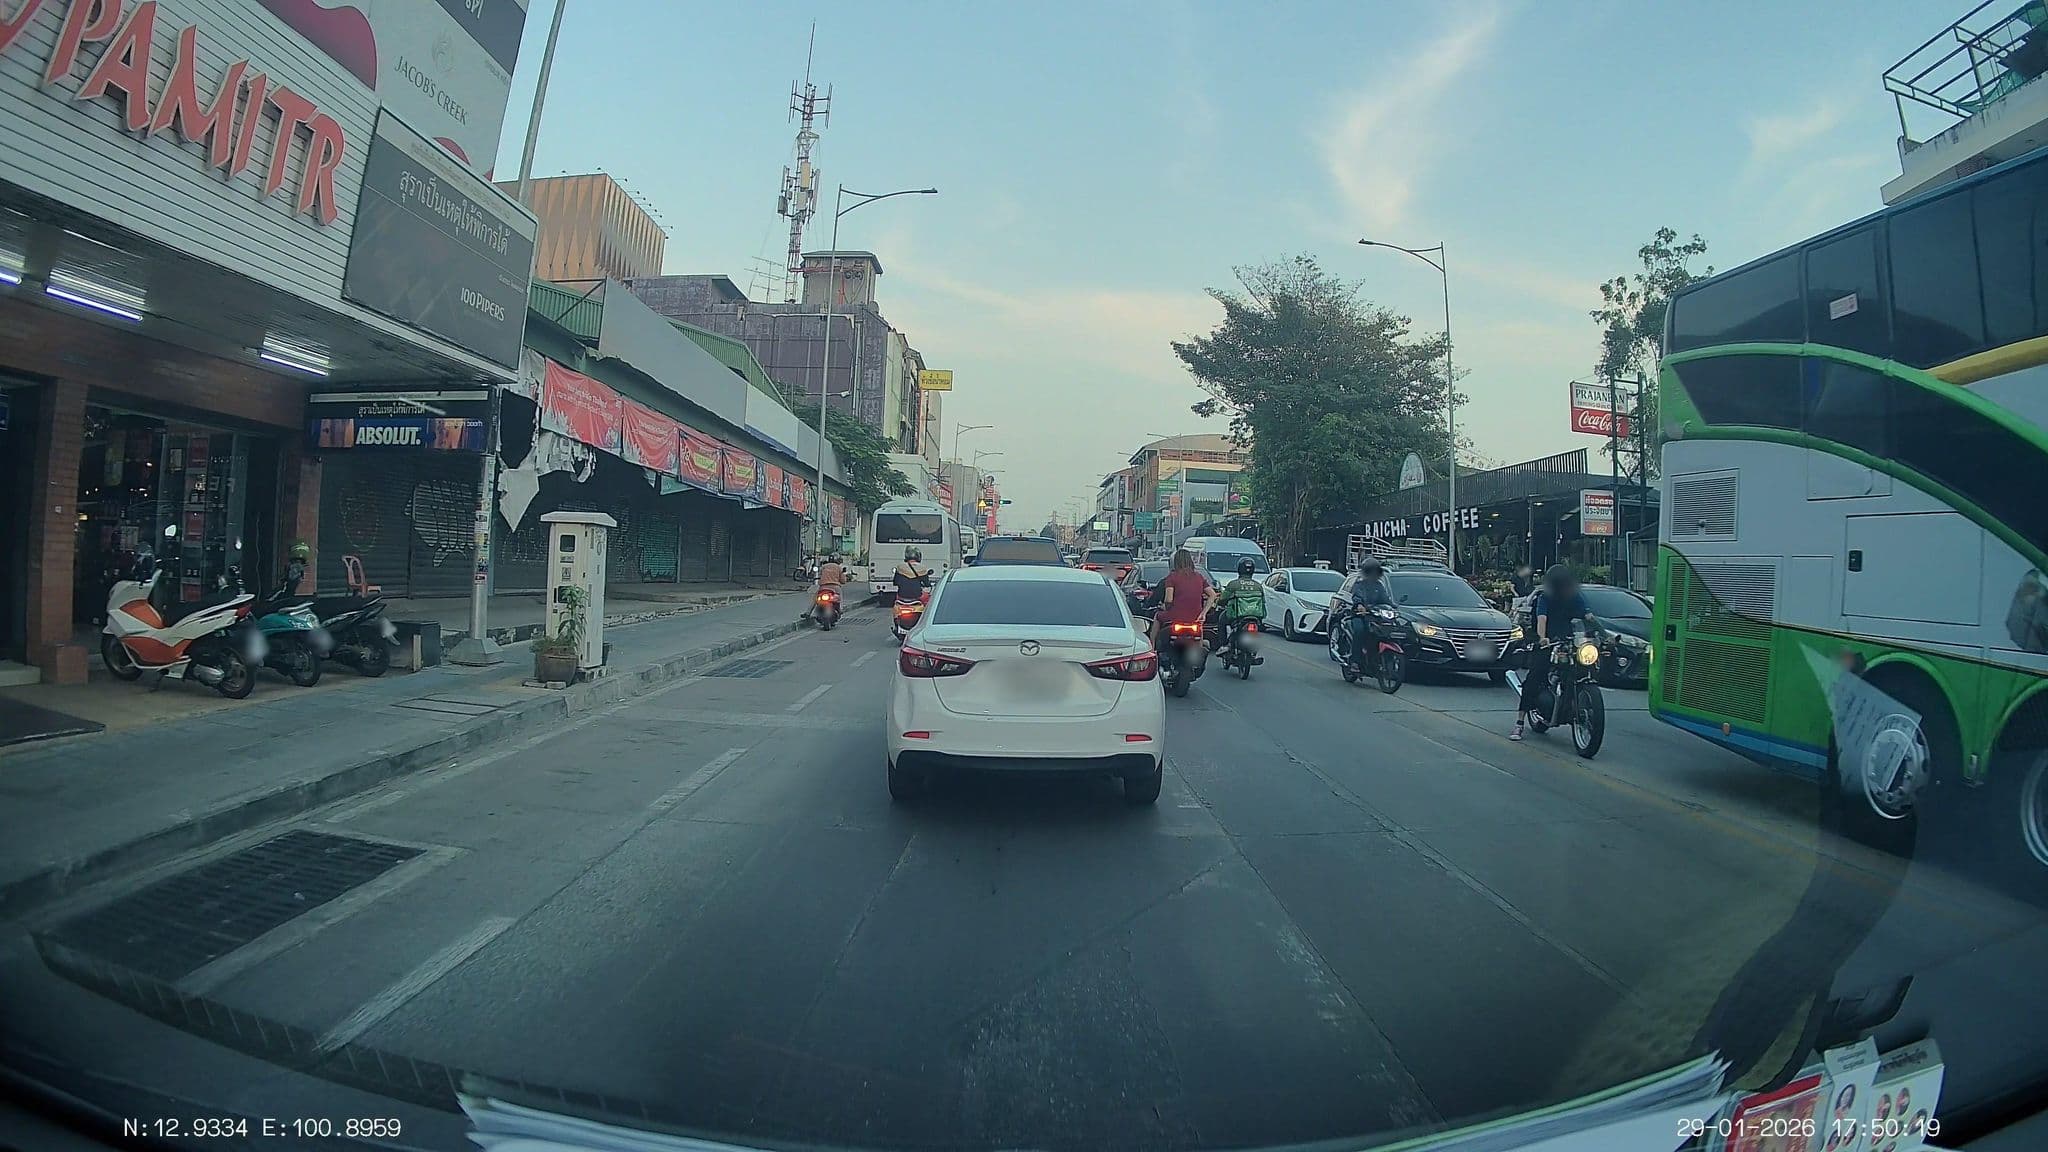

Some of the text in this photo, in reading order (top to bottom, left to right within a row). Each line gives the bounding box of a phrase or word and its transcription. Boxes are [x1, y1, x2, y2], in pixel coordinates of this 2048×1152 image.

[394, 55, 468, 126] JACOB'S CREEK
[399, 170, 511, 256] สุราเป็นเหตุให้พิการได้
[1365, 518, 1407, 540] BAICHA
